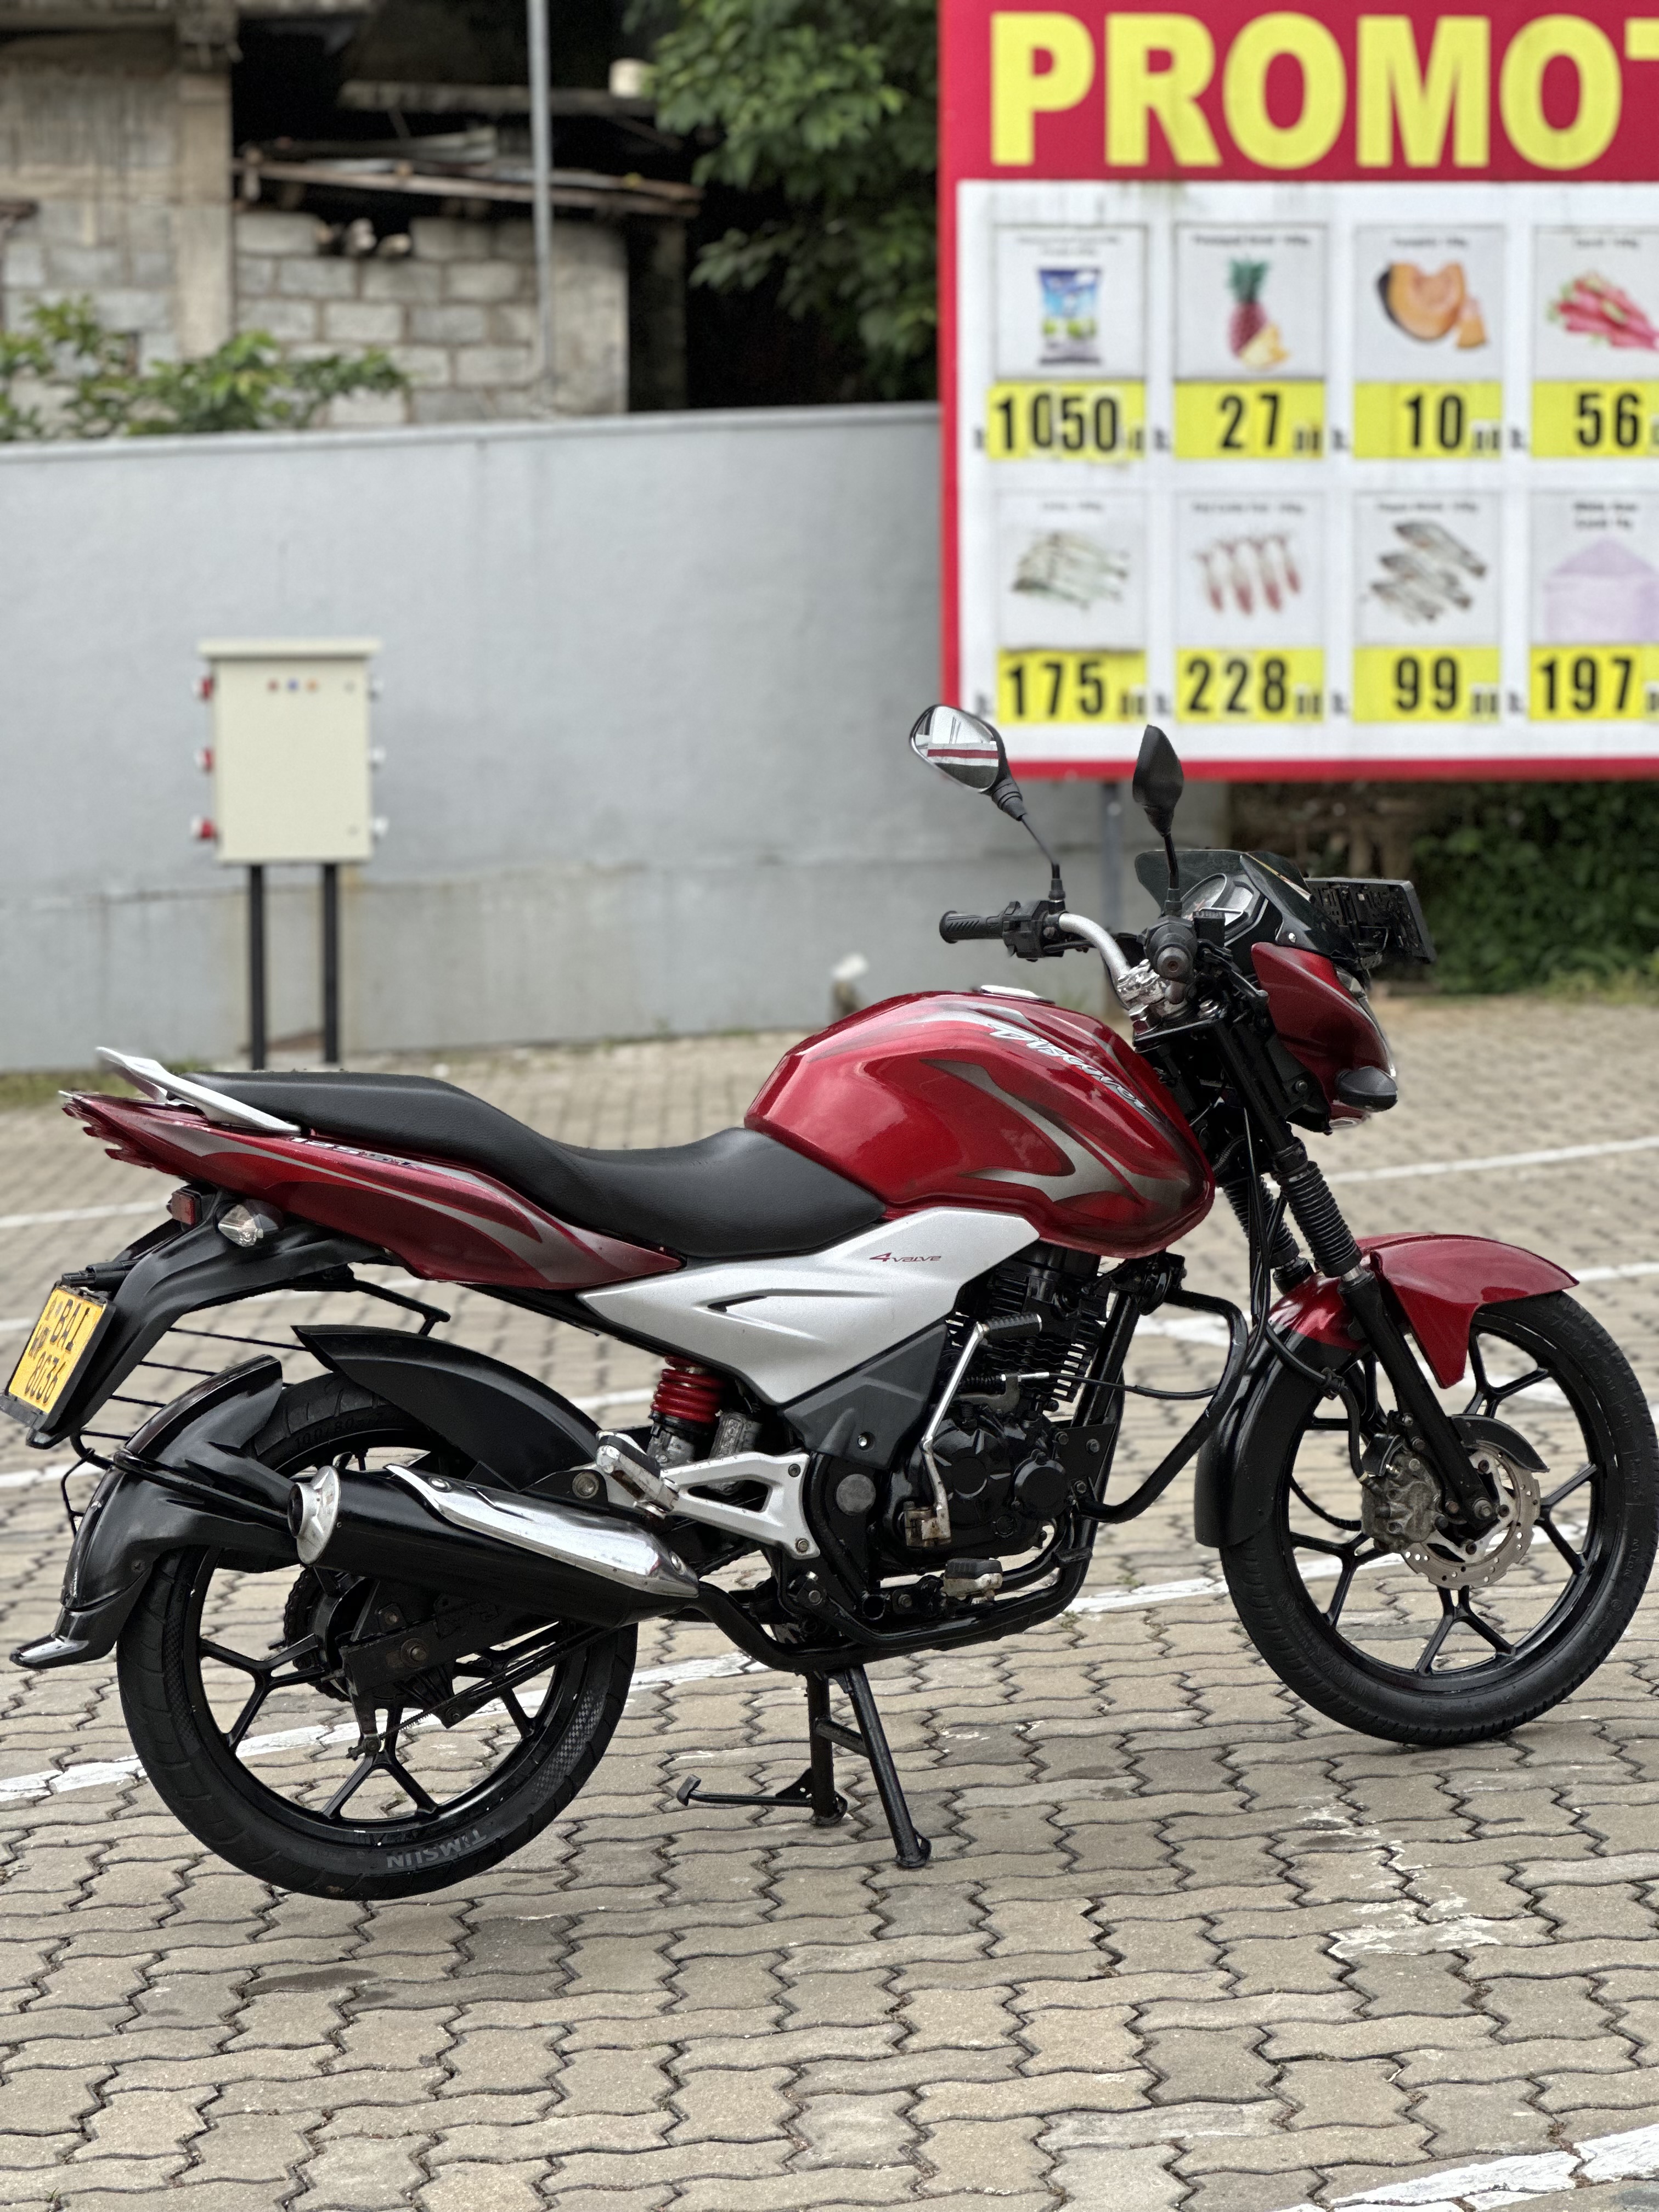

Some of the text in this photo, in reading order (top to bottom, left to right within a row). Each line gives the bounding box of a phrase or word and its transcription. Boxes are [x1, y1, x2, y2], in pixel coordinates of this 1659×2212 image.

[997, 392, 1118, 451] 1050
[1220, 393, 1280, 450] 27
[1406, 393, 1463, 449] 10
[1577, 392, 1642, 447] 56
[1008, 662, 1103, 716] 175
[1188, 658, 1285, 713] 228
[1395, 656, 1458, 711] 99
[1539, 656, 1633, 712] 197
[25, 1351, 66, 1404] 8036
[387, 1829, 487, 1869] TIMSUN
